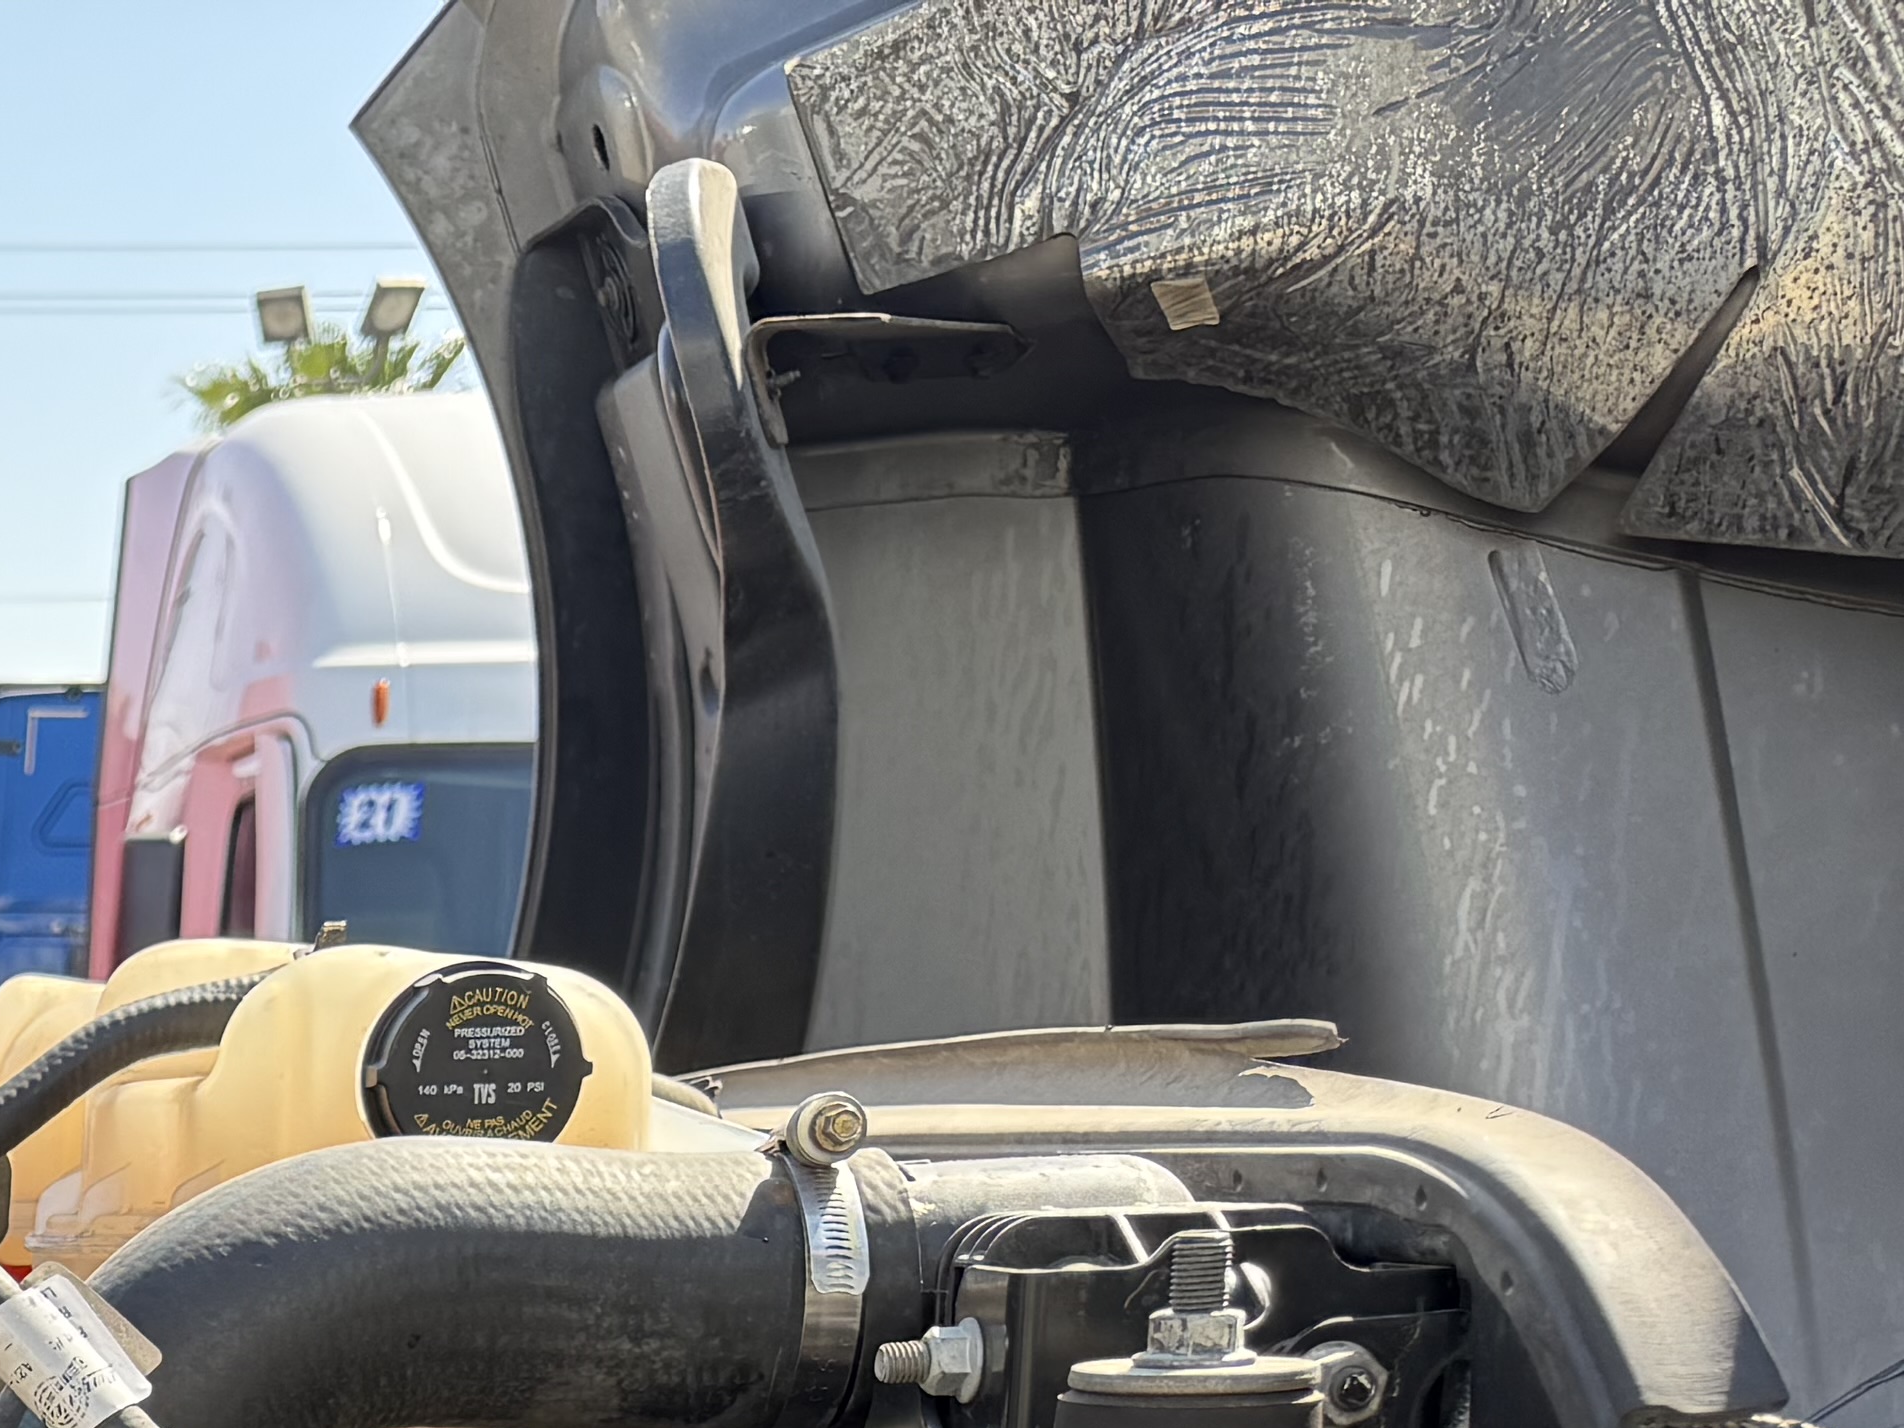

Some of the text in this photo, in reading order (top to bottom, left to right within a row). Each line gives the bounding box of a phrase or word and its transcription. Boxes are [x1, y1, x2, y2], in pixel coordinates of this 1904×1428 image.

[464, 987, 530, 1010] CAUTION
[446, 1005, 534, 1029] NEVER OPEN HOT
[454, 1027, 525, 1038] PRESSURIZED
[541, 1020, 561, 1057] CLOSE
[412, 1028, 431, 1057] OPEN
[468, 1039, 511, 1049] SYSTEM
[453, 1049, 524, 1060] 05-32312-000
[418, 1085, 463, 1095] 140 kPa
[473, 1083, 496, 1104] TVS
[507, 1082, 545, 1093] 20 PSI
[466, 1116, 506, 1129] NE PAS
[496, 1109, 533, 1136] CHAUD
